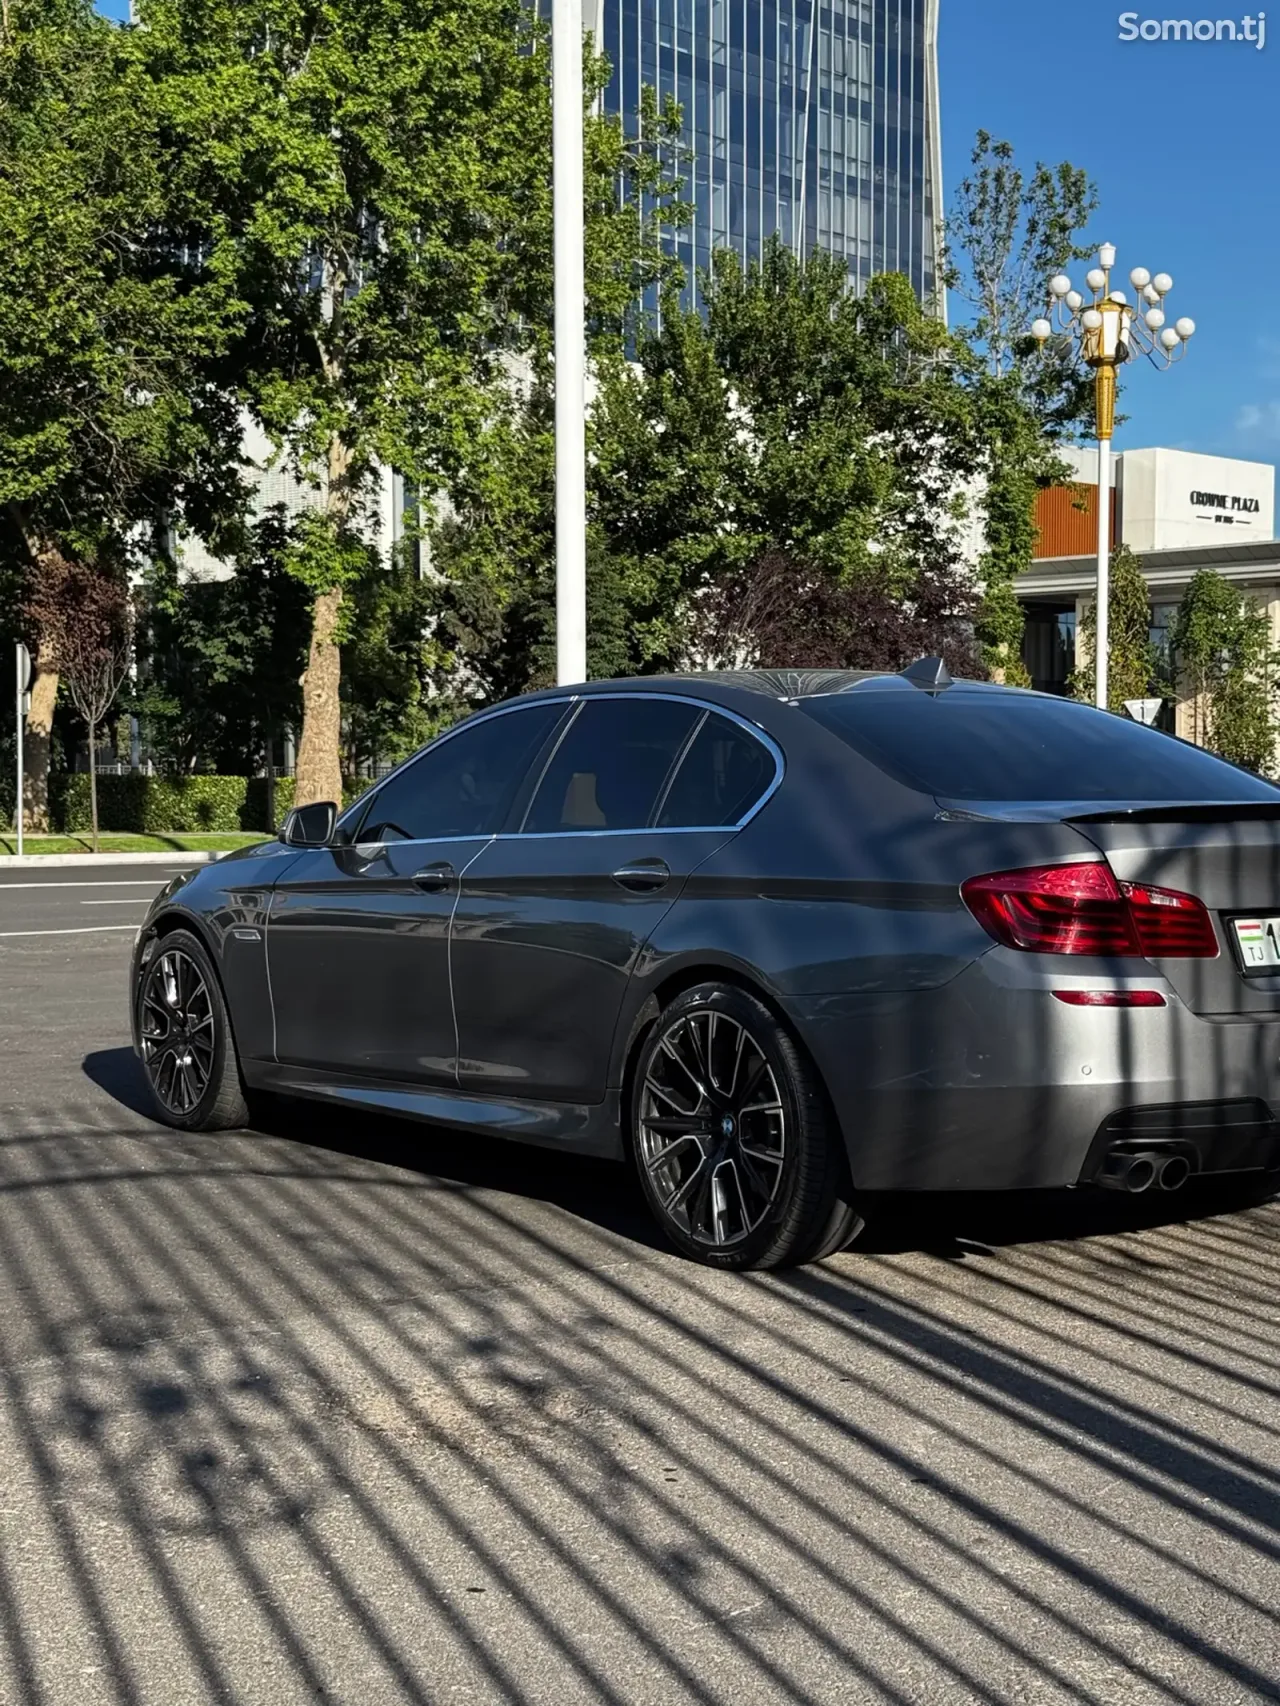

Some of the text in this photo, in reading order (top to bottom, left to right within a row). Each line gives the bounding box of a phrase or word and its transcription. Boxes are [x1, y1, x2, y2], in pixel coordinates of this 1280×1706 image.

[1190, 490, 1260, 513] CROWNE PLAZA
[1248, 947, 1264, 961] TJ
